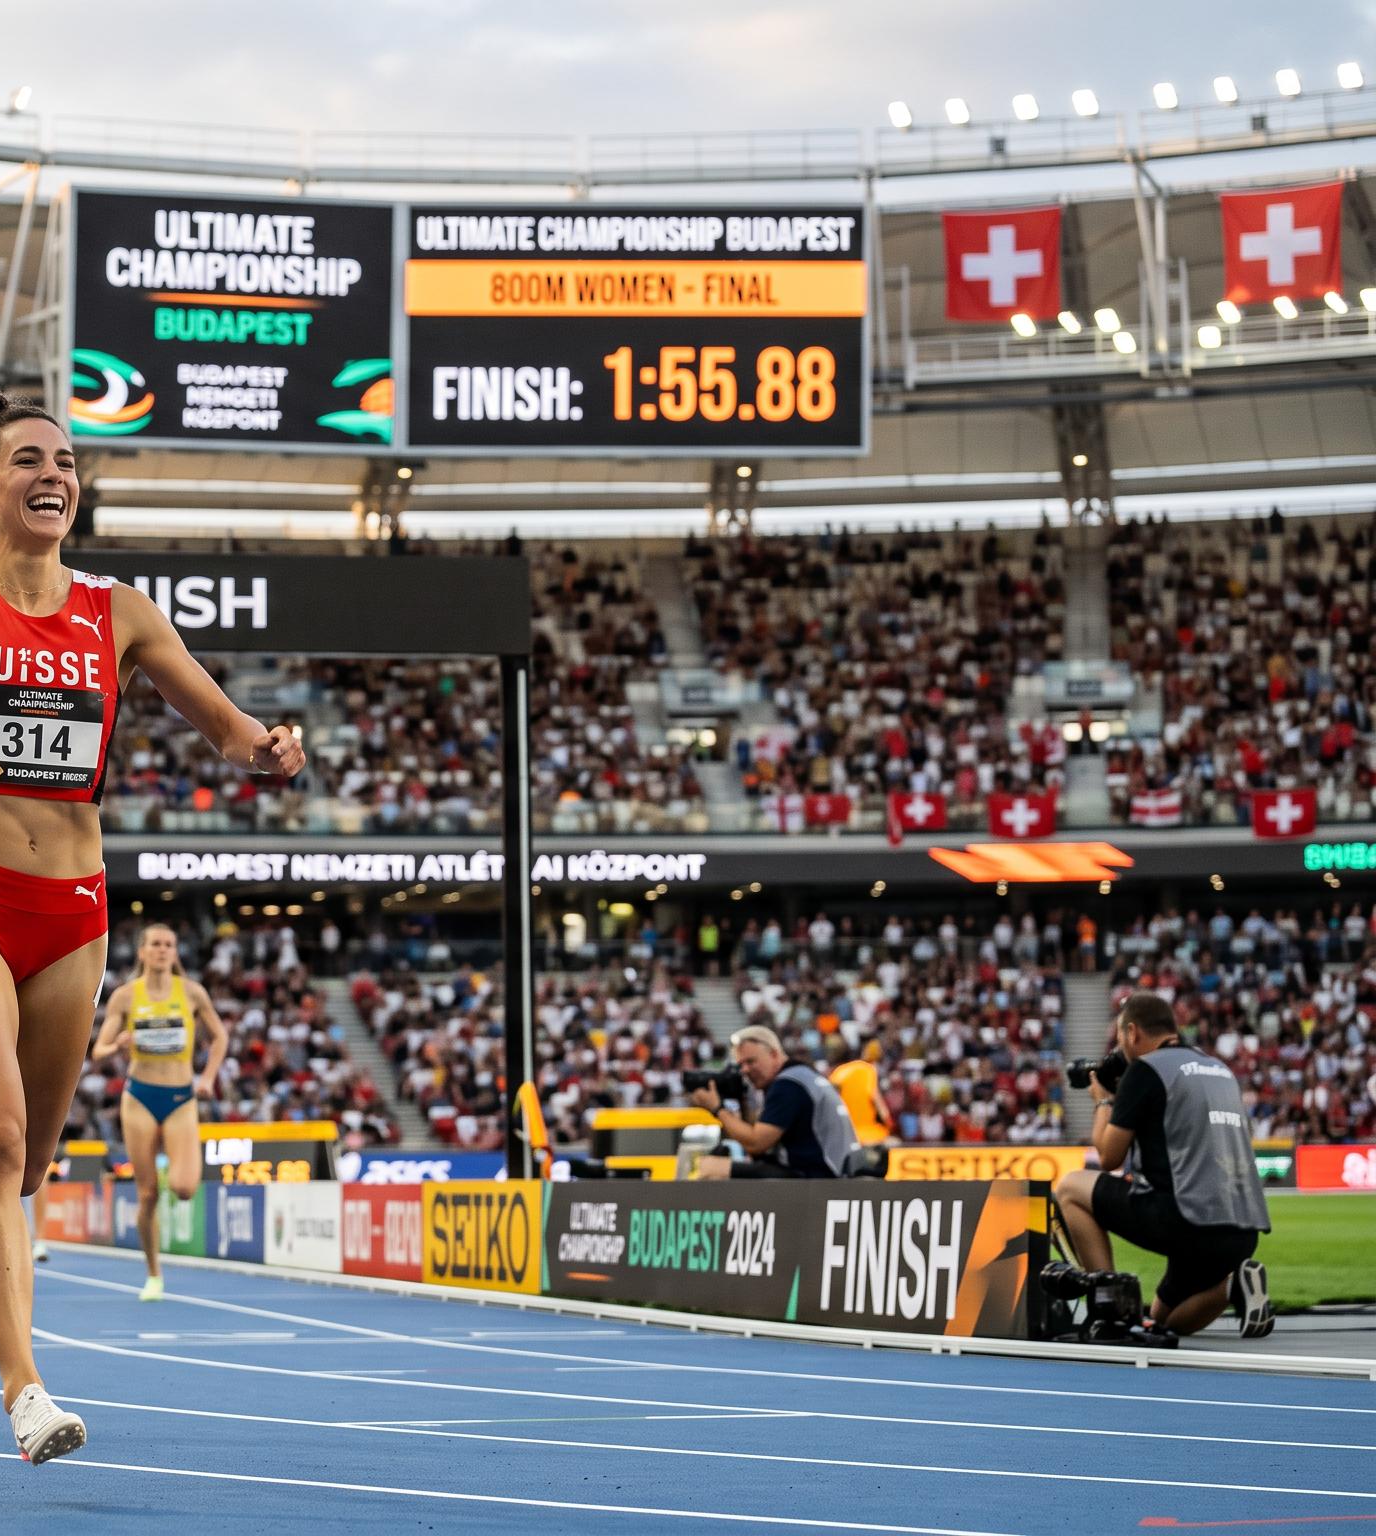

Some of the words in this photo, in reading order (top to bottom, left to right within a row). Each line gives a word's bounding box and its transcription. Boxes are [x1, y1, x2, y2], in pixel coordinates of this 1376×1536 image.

[154, 209, 315, 255] ULTIMATE
[416, 216, 536, 251] ULTIMATE
[537, 216, 723, 251] CHAMPIONSHIP
[725, 217, 855, 251] BUDAPEST
[106, 247, 362, 296] CHAMPIONSHIP
[490, 272, 565, 305] 800M
[575, 272, 676, 305] WOMEN
[703, 273, 778, 305] FINAL
[153, 307, 312, 345] BUDAPEST
[177, 363, 288, 388] BUDAPEST
[433, 366, 584, 421] FINISH:
[603, 345, 837, 423] 1:55.88
[134, 576, 268, 629] ISH
[19, 690, 63, 701] ULTIMATE
[1, 721, 72, 761] 314
[7, 768, 61, 780] BUDAPEST
[138, 853, 288, 880] BUDAPEST
[291, 854, 416, 881] NEMZETI
[900, 1153, 1059, 1180] SEIKO
[431, 1192, 529, 1284] SEIKO
[628, 1209, 725, 1272] BUDAPEST
[725, 1210, 776, 1276] 2024
[820, 1198, 963, 1320] FINISH
